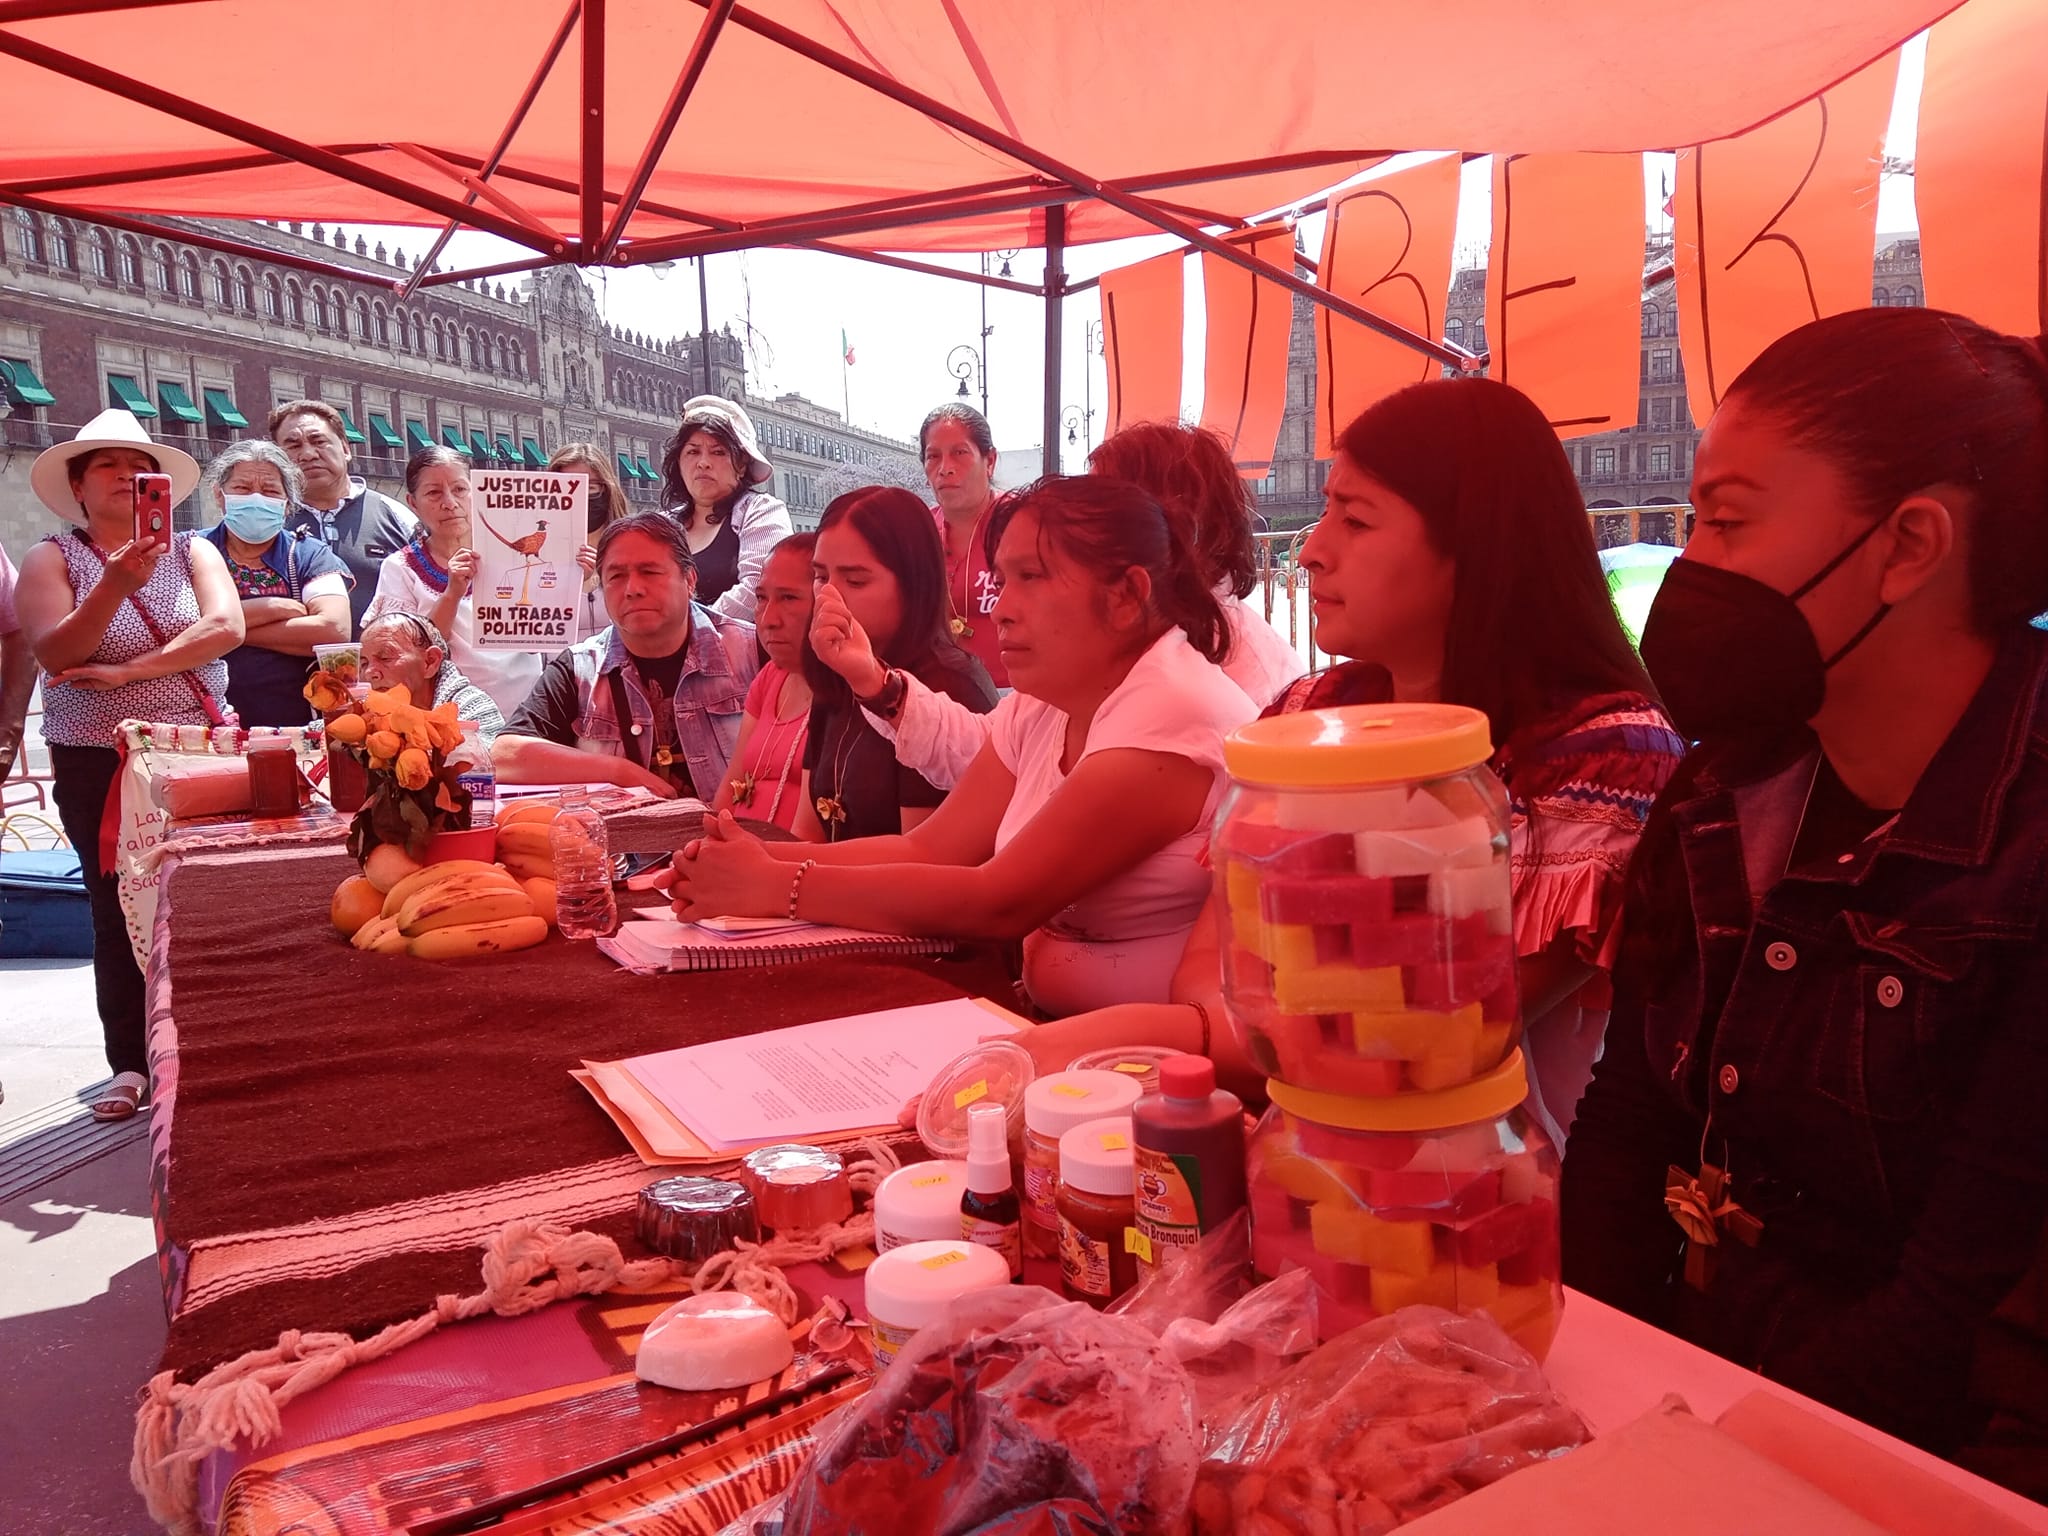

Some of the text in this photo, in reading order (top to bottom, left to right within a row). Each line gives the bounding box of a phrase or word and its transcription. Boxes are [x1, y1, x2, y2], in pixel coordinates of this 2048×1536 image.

[477, 477, 580, 495] JUSTICIA Y
[486, 494, 573, 511] LIBERTAD
[477, 607, 573, 621] SIN TRABAS
[483, 620, 566, 636] POLÍTICAS
[135, 811, 163, 828] Las
[1151, 1223, 1199, 1247] Bronquial
